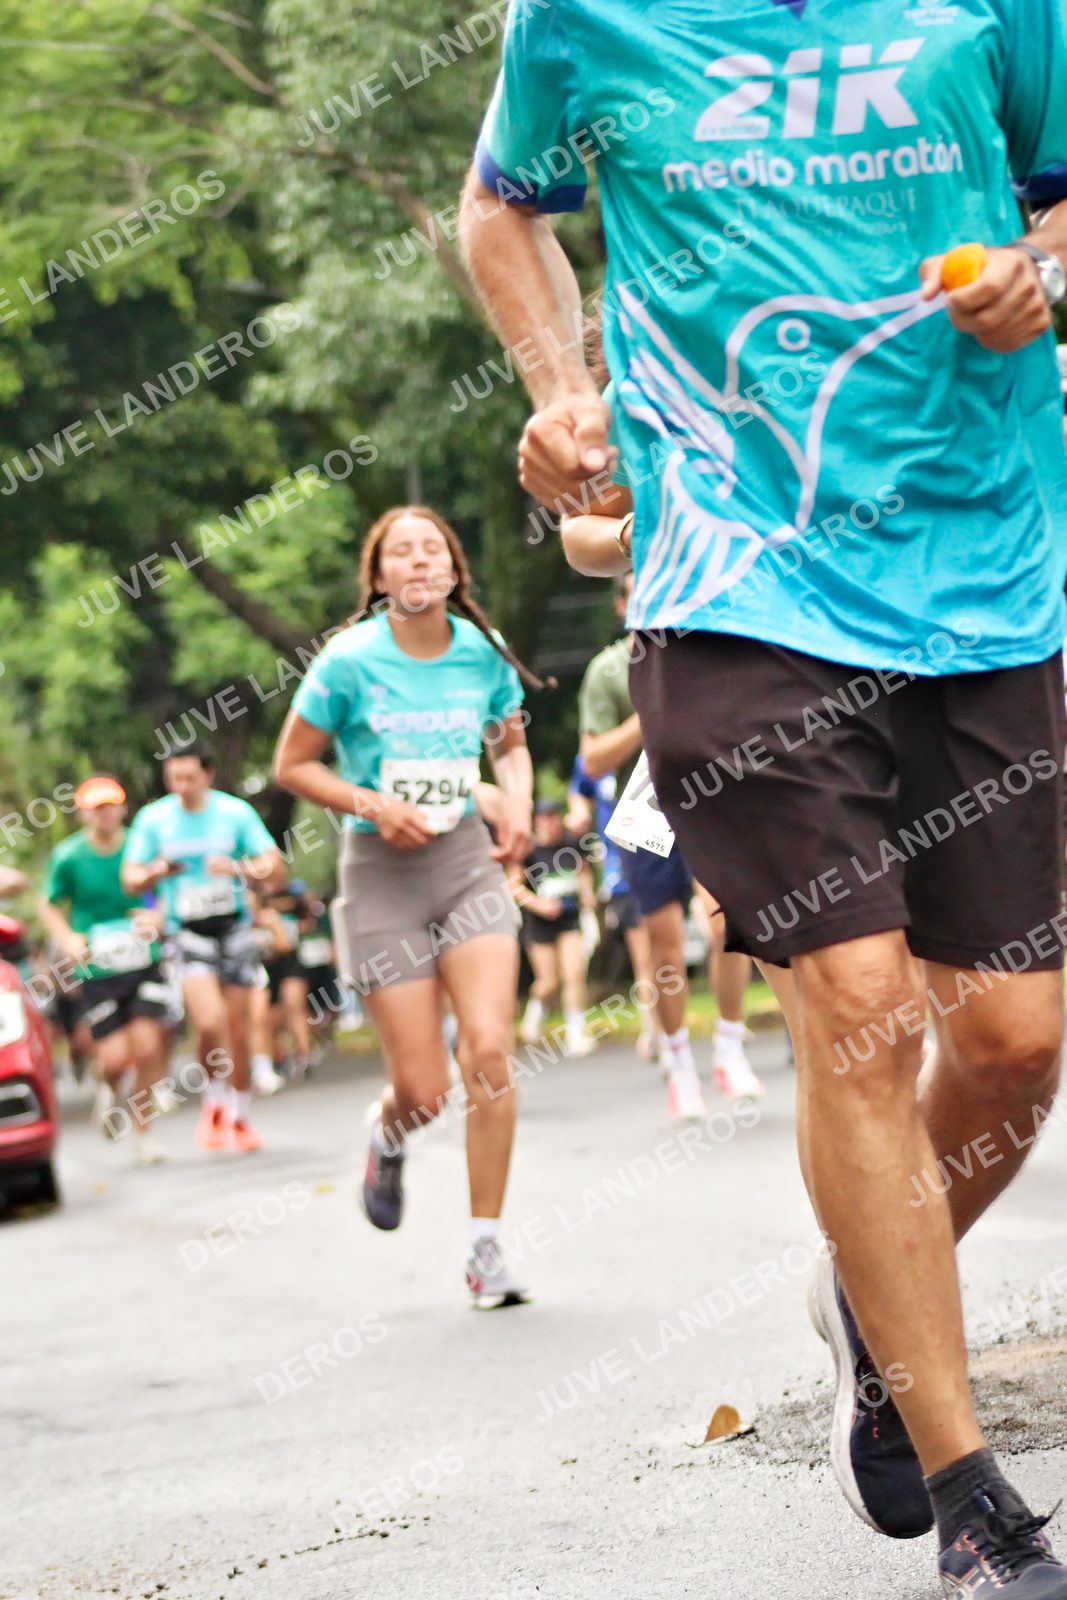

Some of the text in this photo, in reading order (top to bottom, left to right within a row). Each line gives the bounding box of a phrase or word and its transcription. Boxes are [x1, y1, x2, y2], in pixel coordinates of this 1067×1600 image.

[662, 135, 964, 193] medio maratón
[644, 839, 666, 853] 4575
